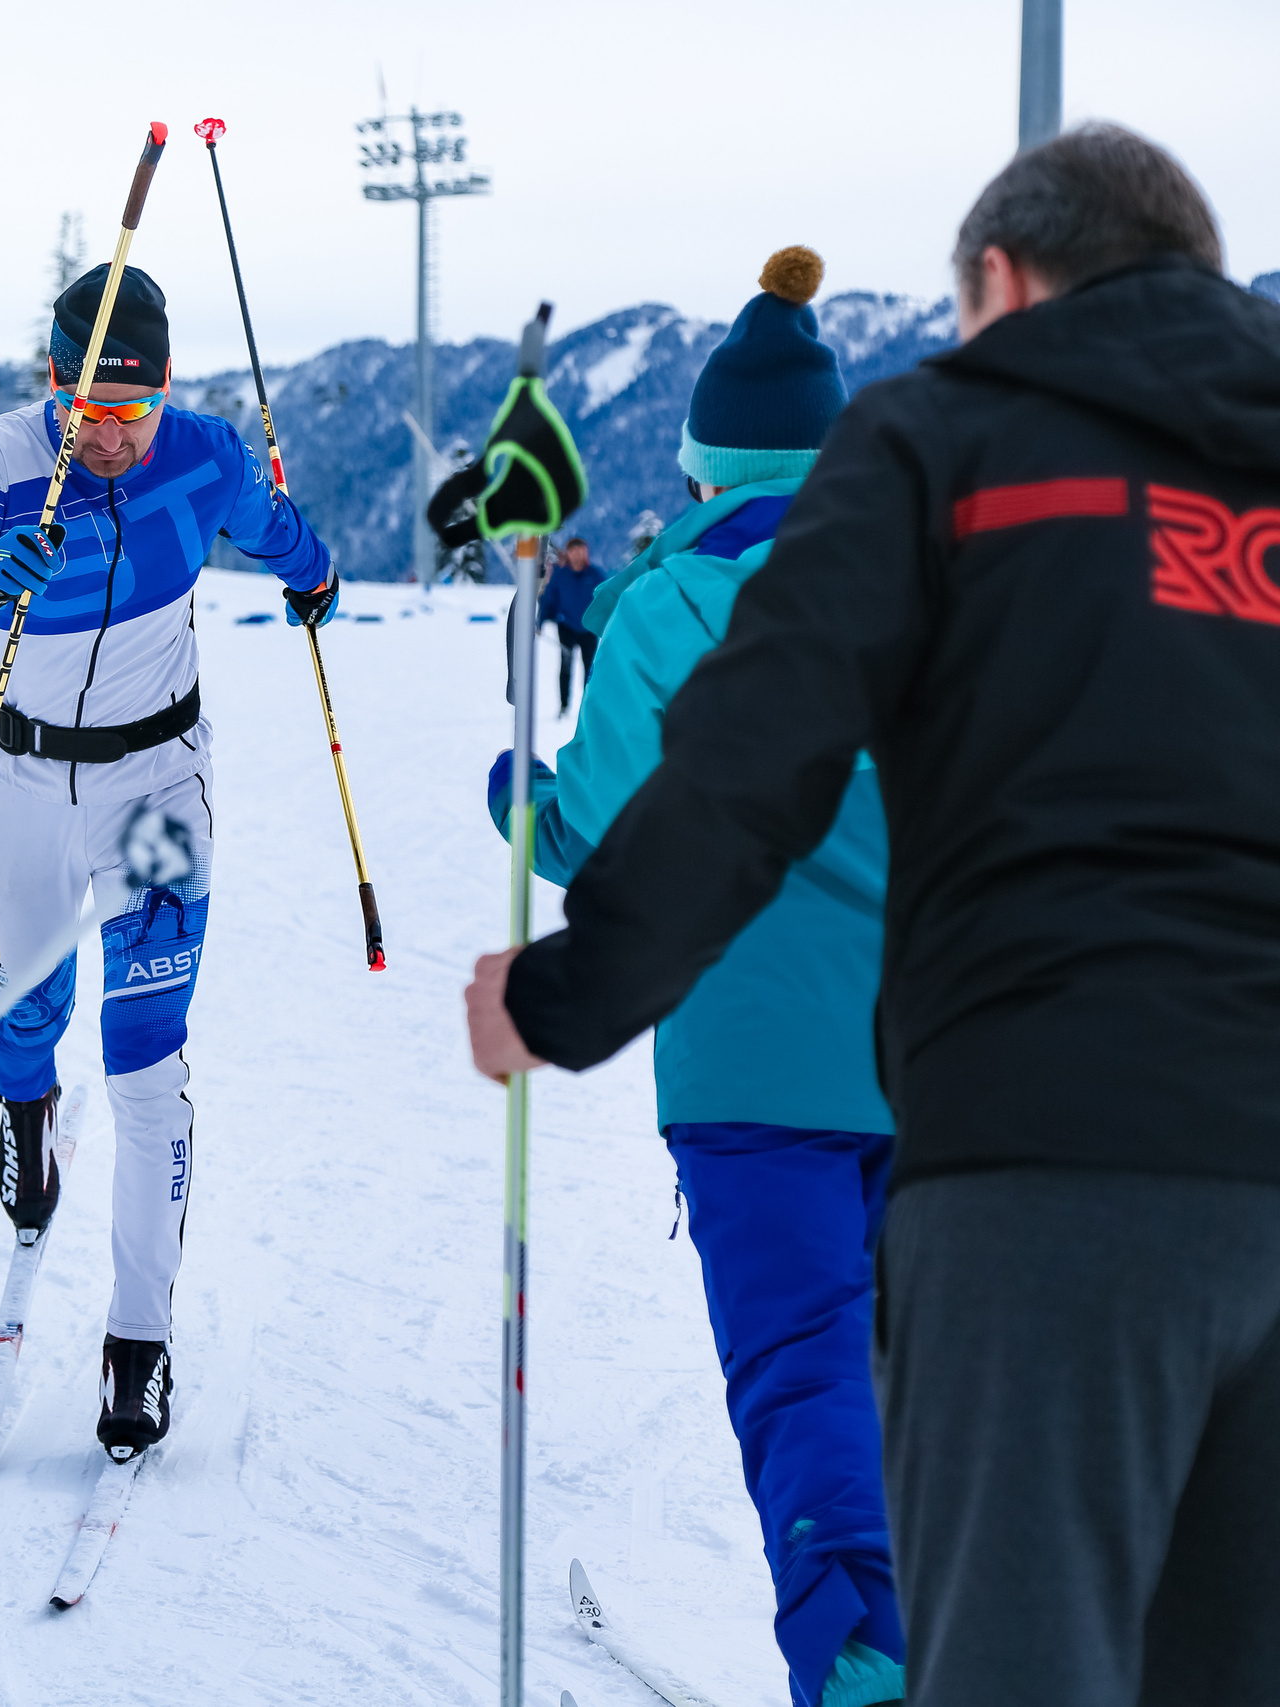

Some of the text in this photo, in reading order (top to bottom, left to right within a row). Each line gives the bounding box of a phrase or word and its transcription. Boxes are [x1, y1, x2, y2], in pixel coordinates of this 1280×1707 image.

[34, 532, 54, 557] KV+
[125, 943, 201, 983] ABST
[170, 1139, 186, 1202] RUS
